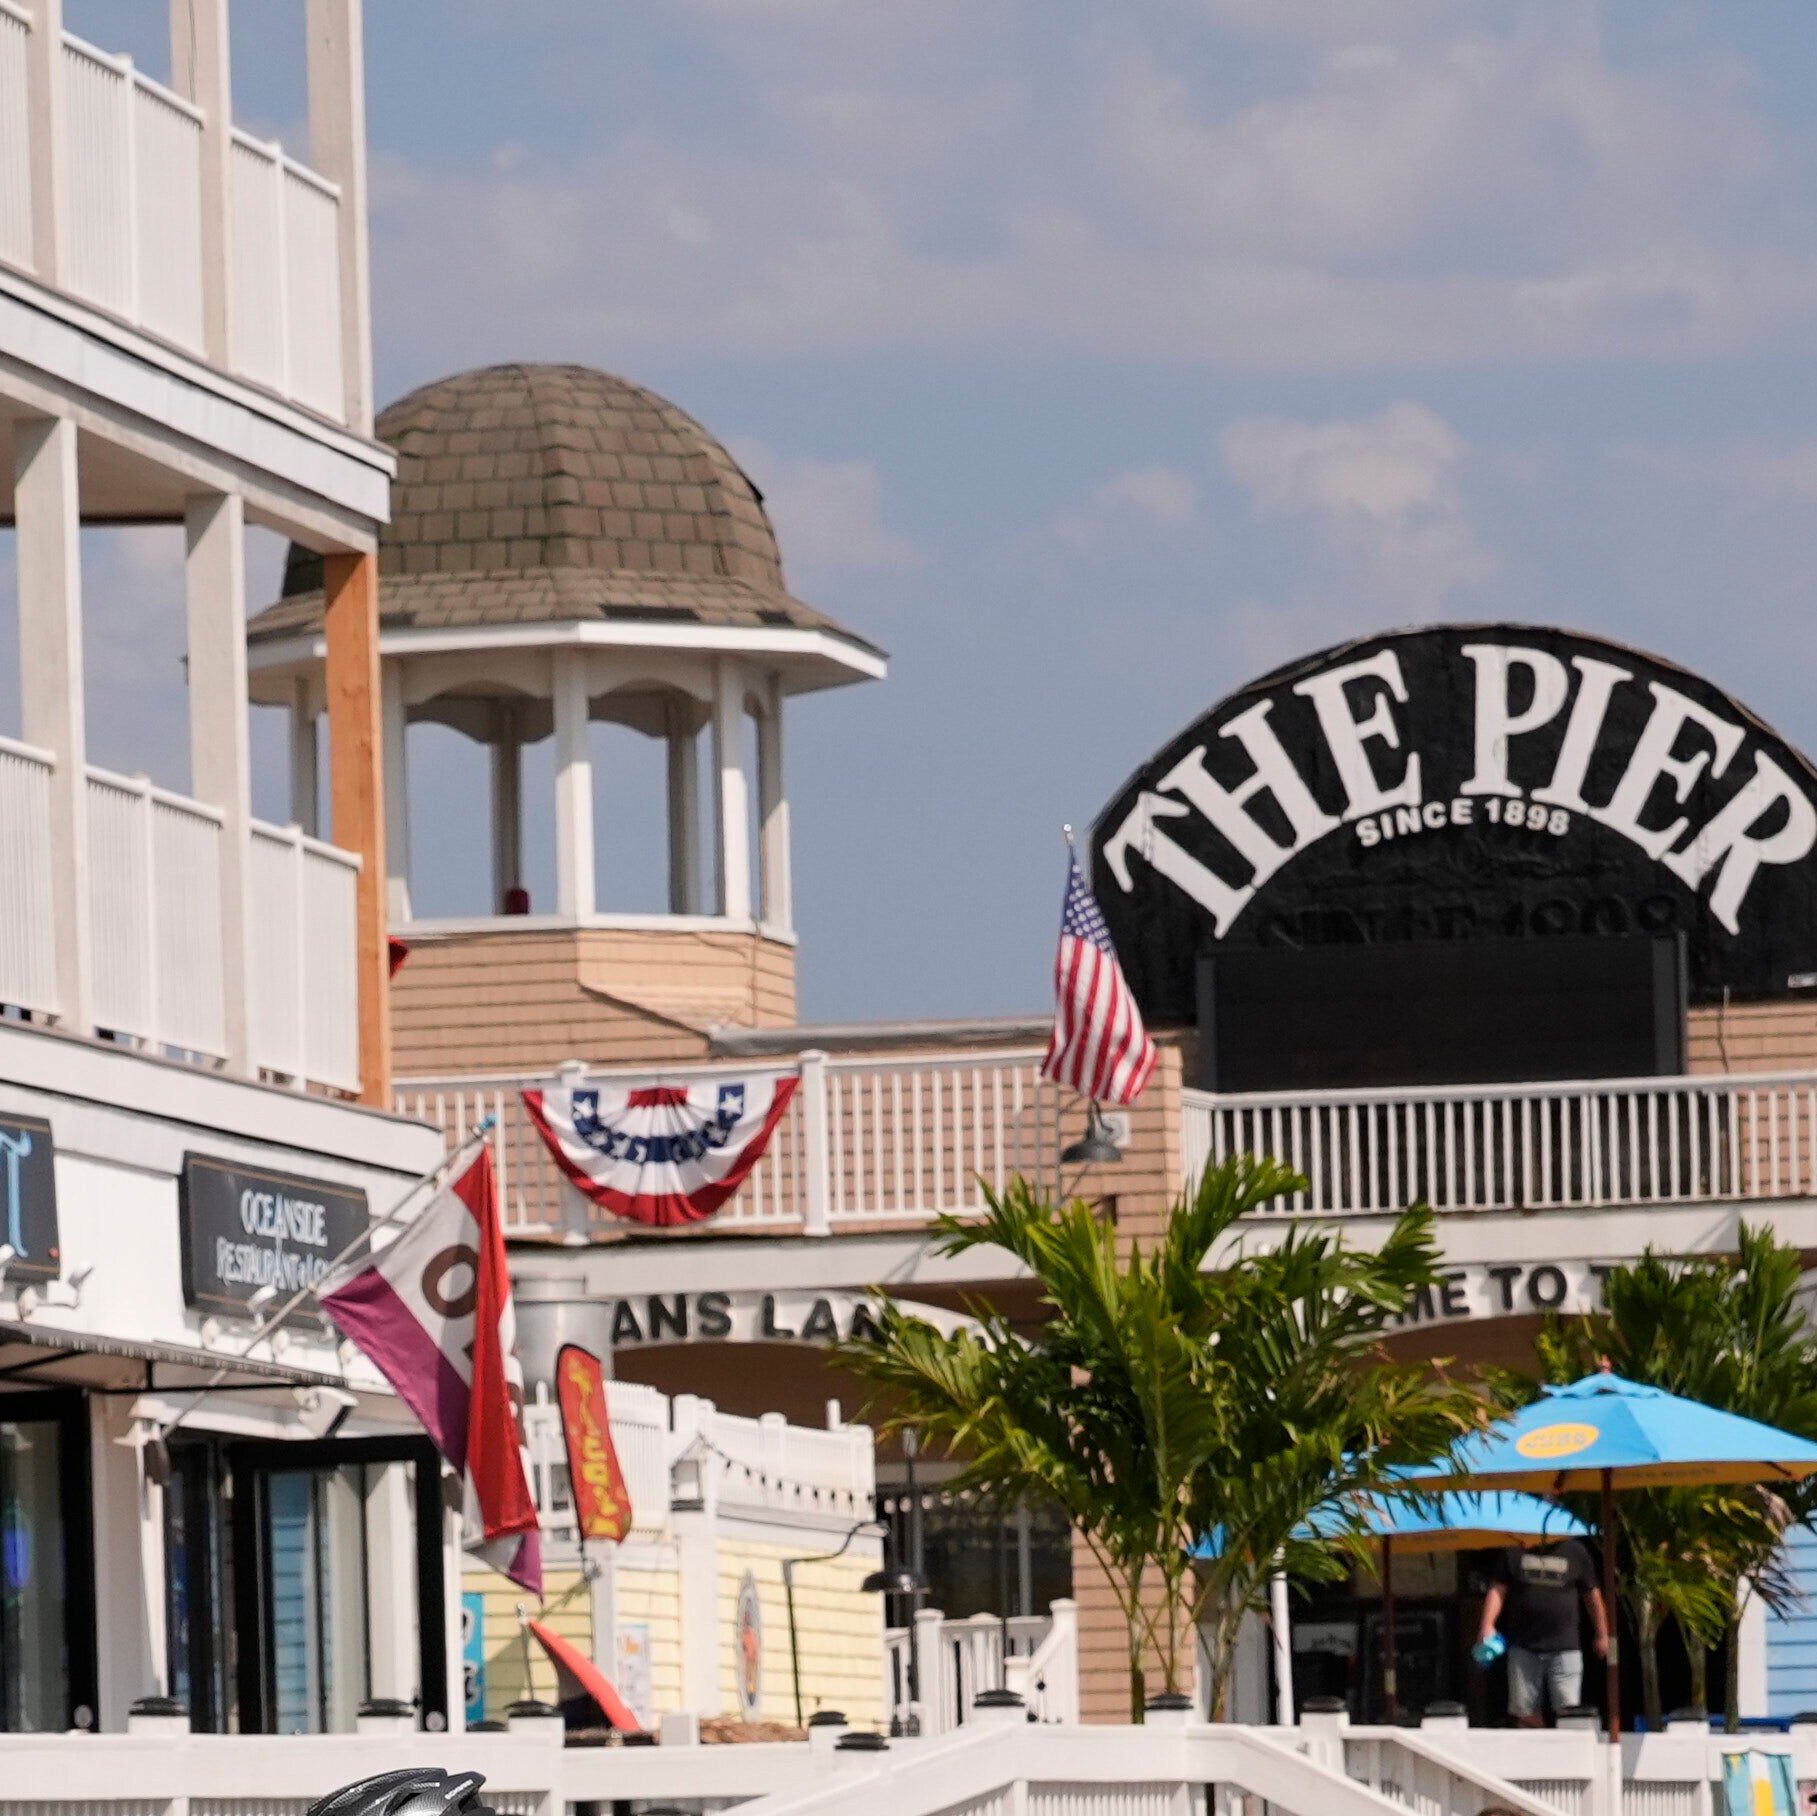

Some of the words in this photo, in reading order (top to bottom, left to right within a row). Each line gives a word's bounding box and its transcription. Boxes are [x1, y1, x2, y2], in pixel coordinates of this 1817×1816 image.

[1102, 649, 1424, 940] THE
[1355, 799, 1473, 848] SINCE
[1484, 797, 1571, 837] 1898
[1488, 1265, 1568, 1311] TO
